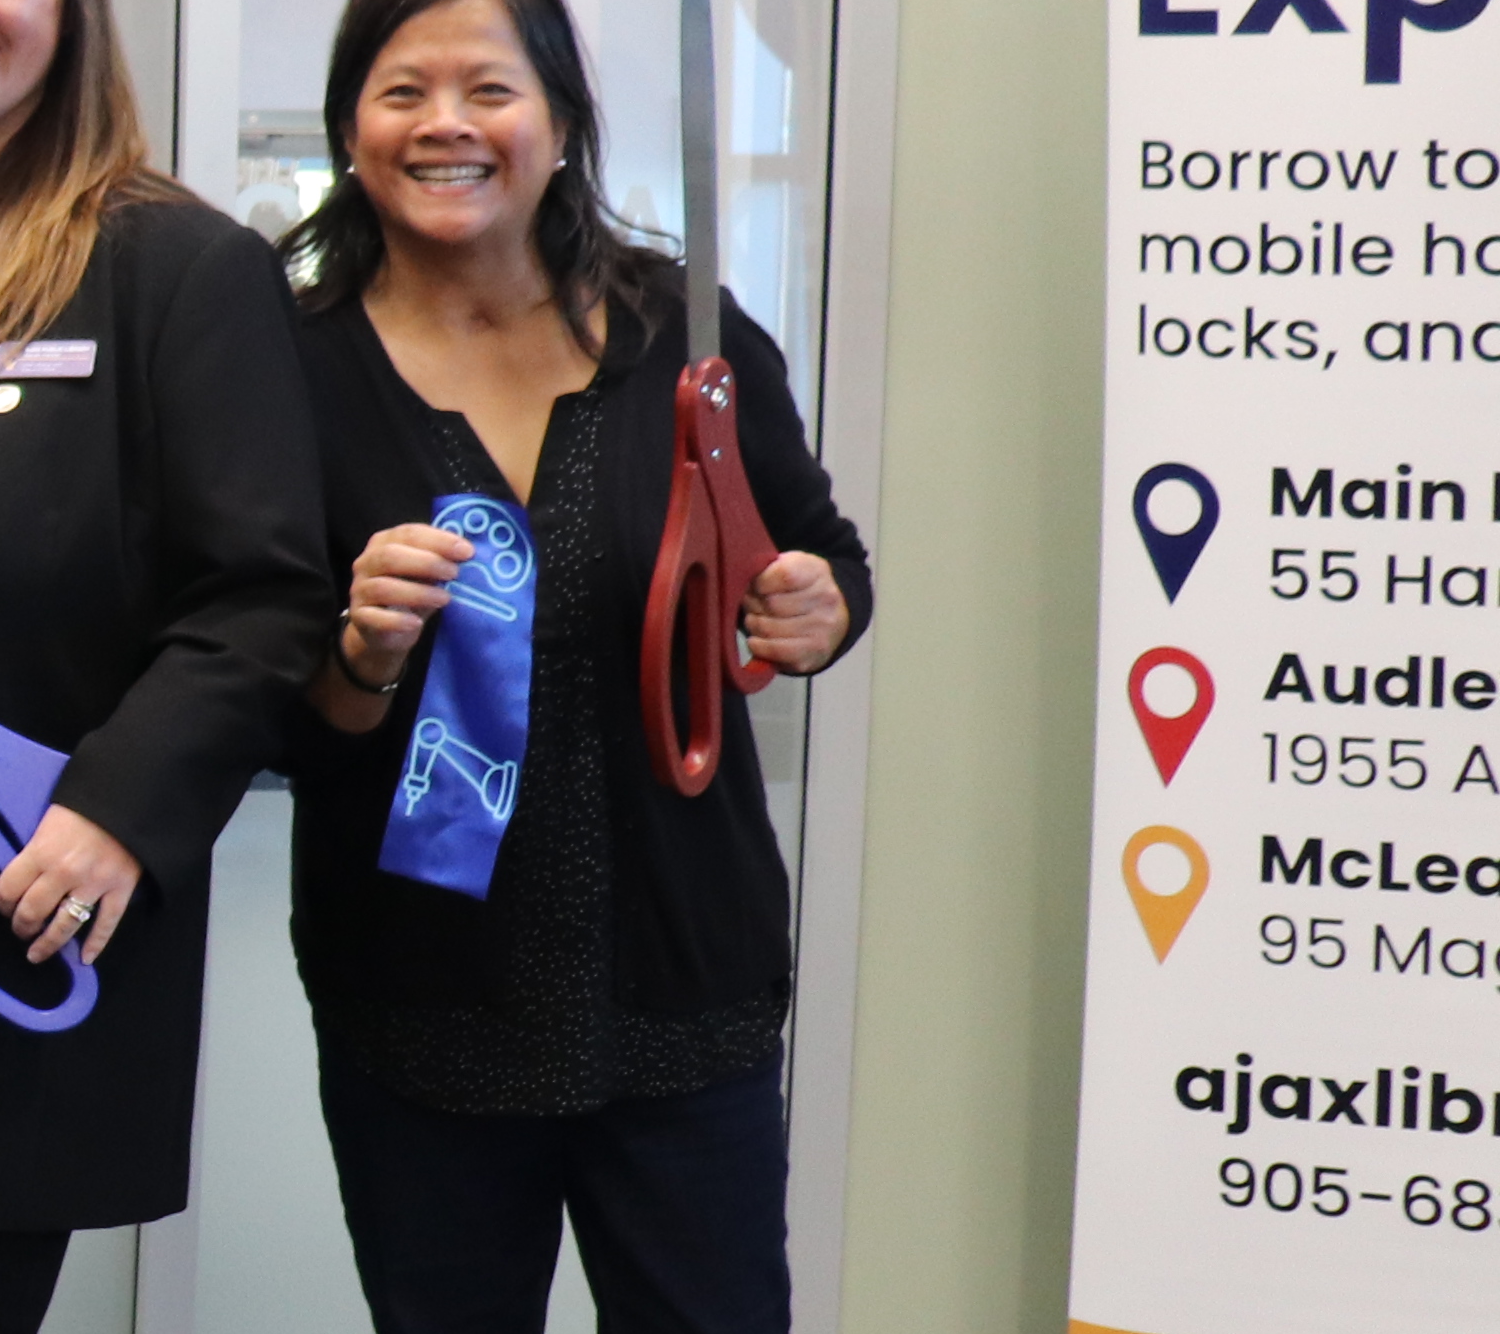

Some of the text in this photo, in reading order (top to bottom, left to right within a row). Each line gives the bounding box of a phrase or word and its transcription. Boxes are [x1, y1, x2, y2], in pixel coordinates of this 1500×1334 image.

[1140, 140, 1500, 191] Borrow to
[1139, 221, 1395, 277] mobile
[1137, 304, 1337, 373] locks,
[1270, 463, 1467, 523] Main
[1268, 548, 1500, 608] 55 Ha
[1264, 732, 1429, 793] 1955
[1259, 914, 1500, 993] 95 Ma
[1218, 1156, 1500, 1235] 905-68
